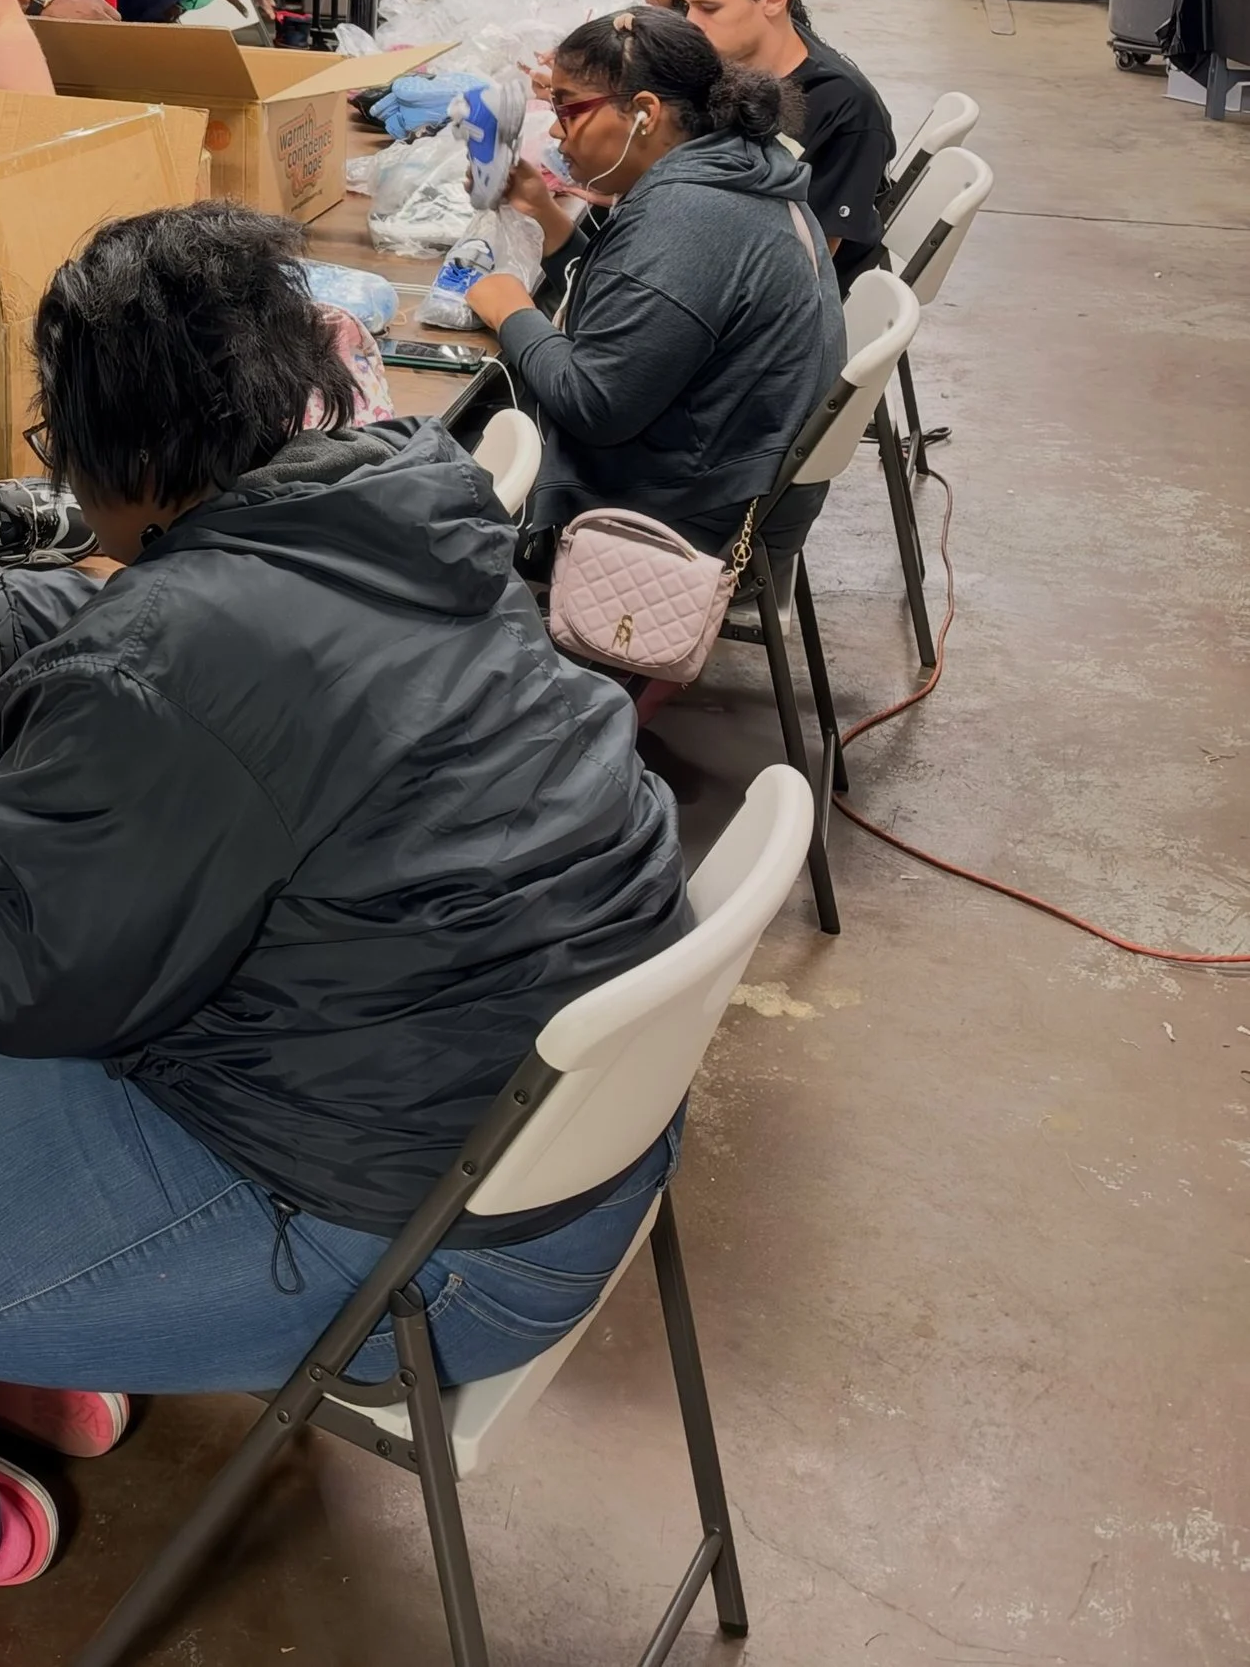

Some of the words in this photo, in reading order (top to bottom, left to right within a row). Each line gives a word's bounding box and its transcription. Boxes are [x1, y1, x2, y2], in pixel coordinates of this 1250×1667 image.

[279, 118, 314, 152] warmth
[287, 129, 332, 169] confidence
[303, 155, 322, 180] hope
